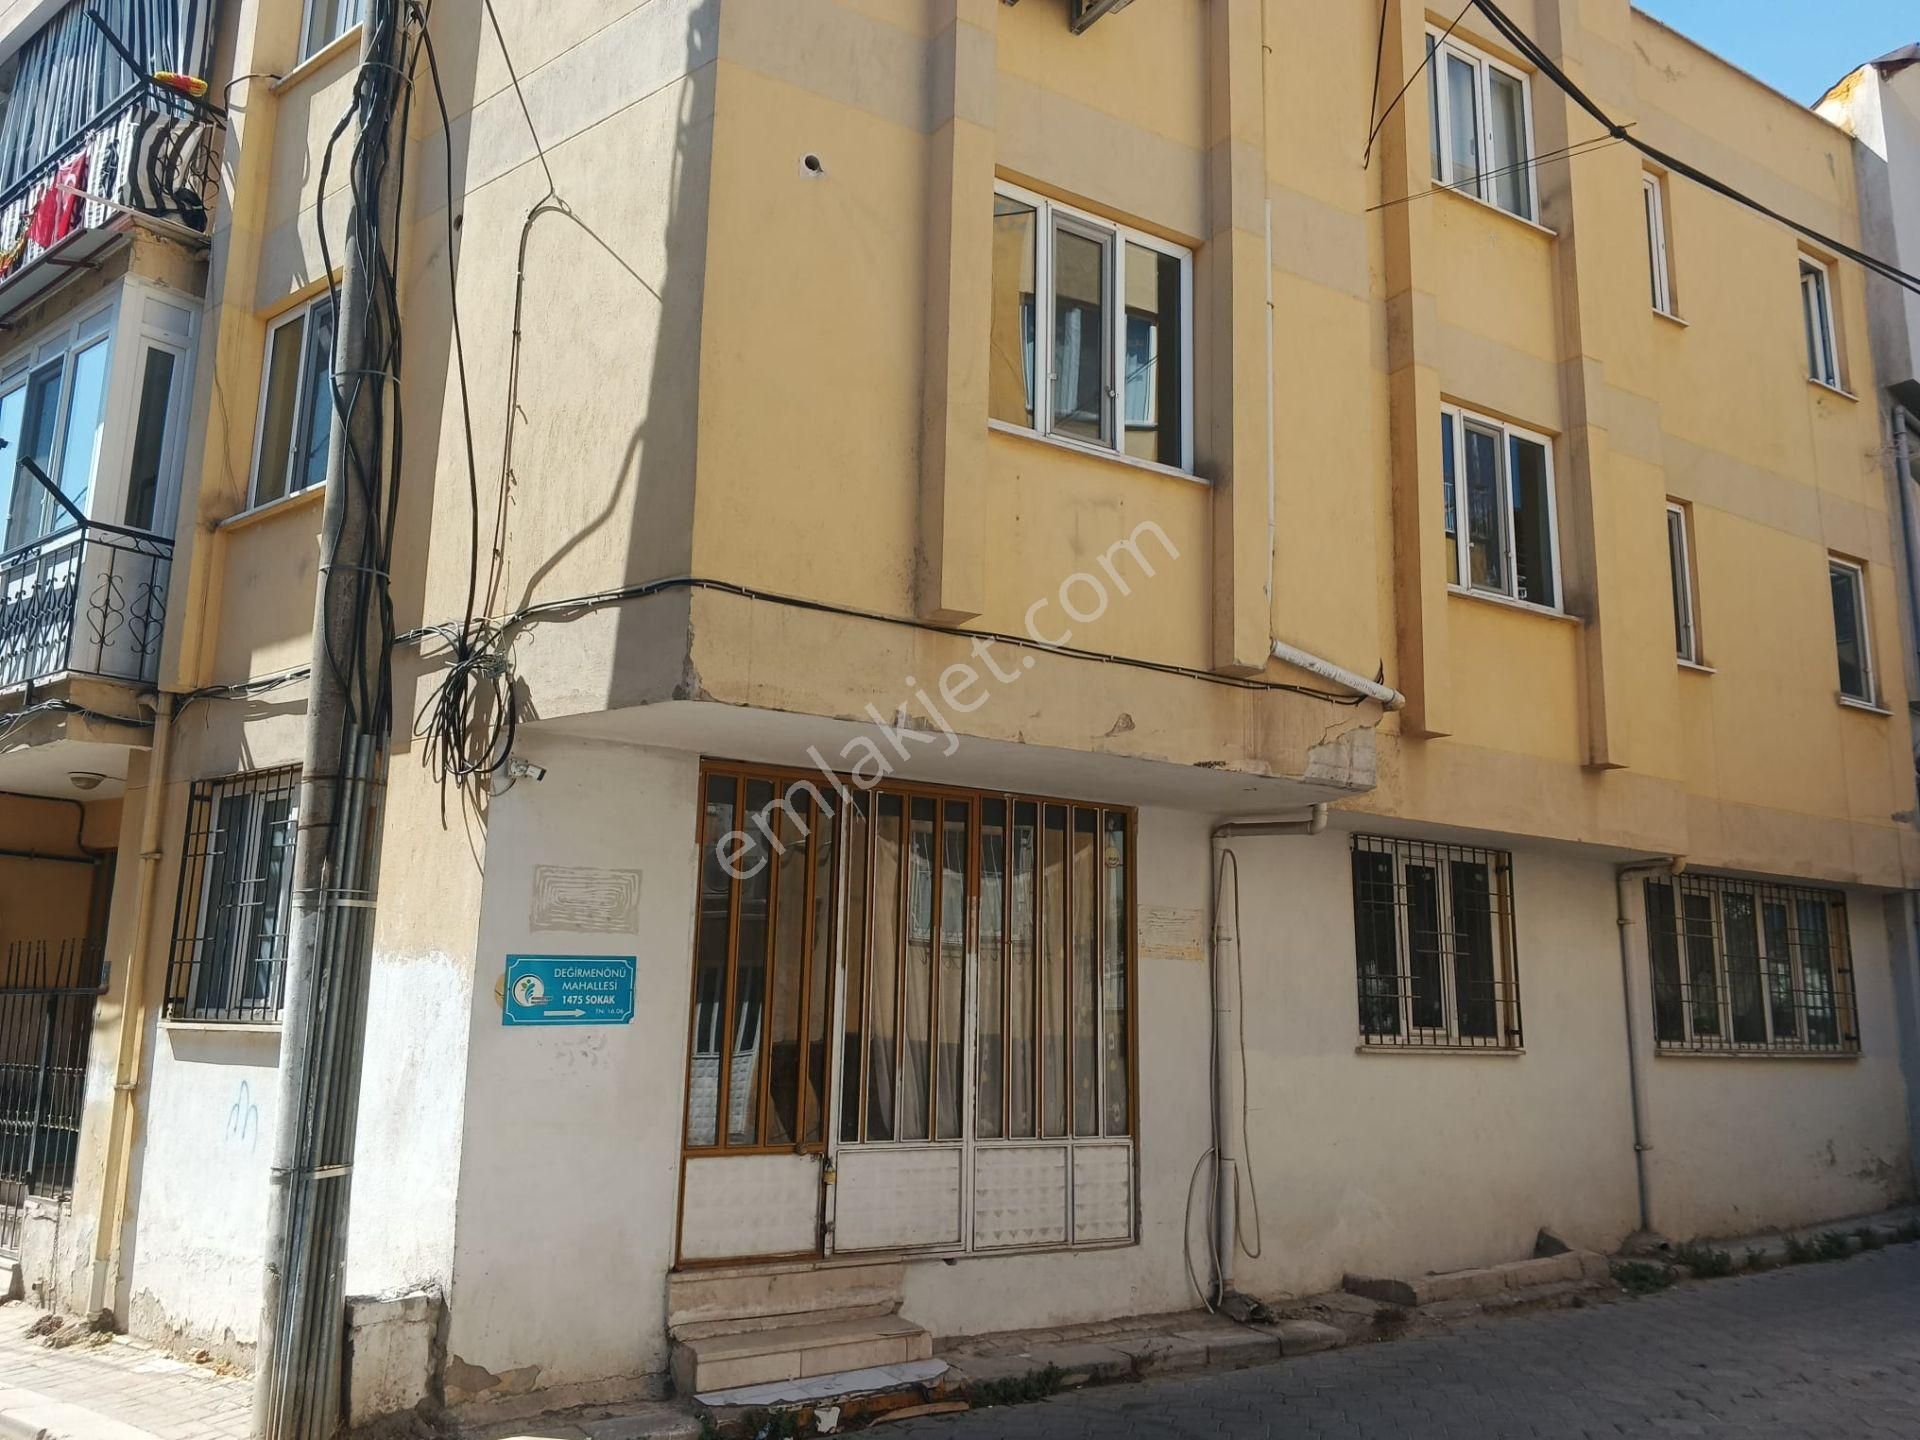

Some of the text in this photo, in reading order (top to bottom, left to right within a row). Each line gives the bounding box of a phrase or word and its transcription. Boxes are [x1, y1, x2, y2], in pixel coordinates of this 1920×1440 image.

[553, 966, 627, 978] DEĞİRMENÖNÜ
[562, 979, 618, 991] MAHALLESİ
[562, 995, 583, 1005] 1475
[585, 995, 616, 1005] SOKAK
